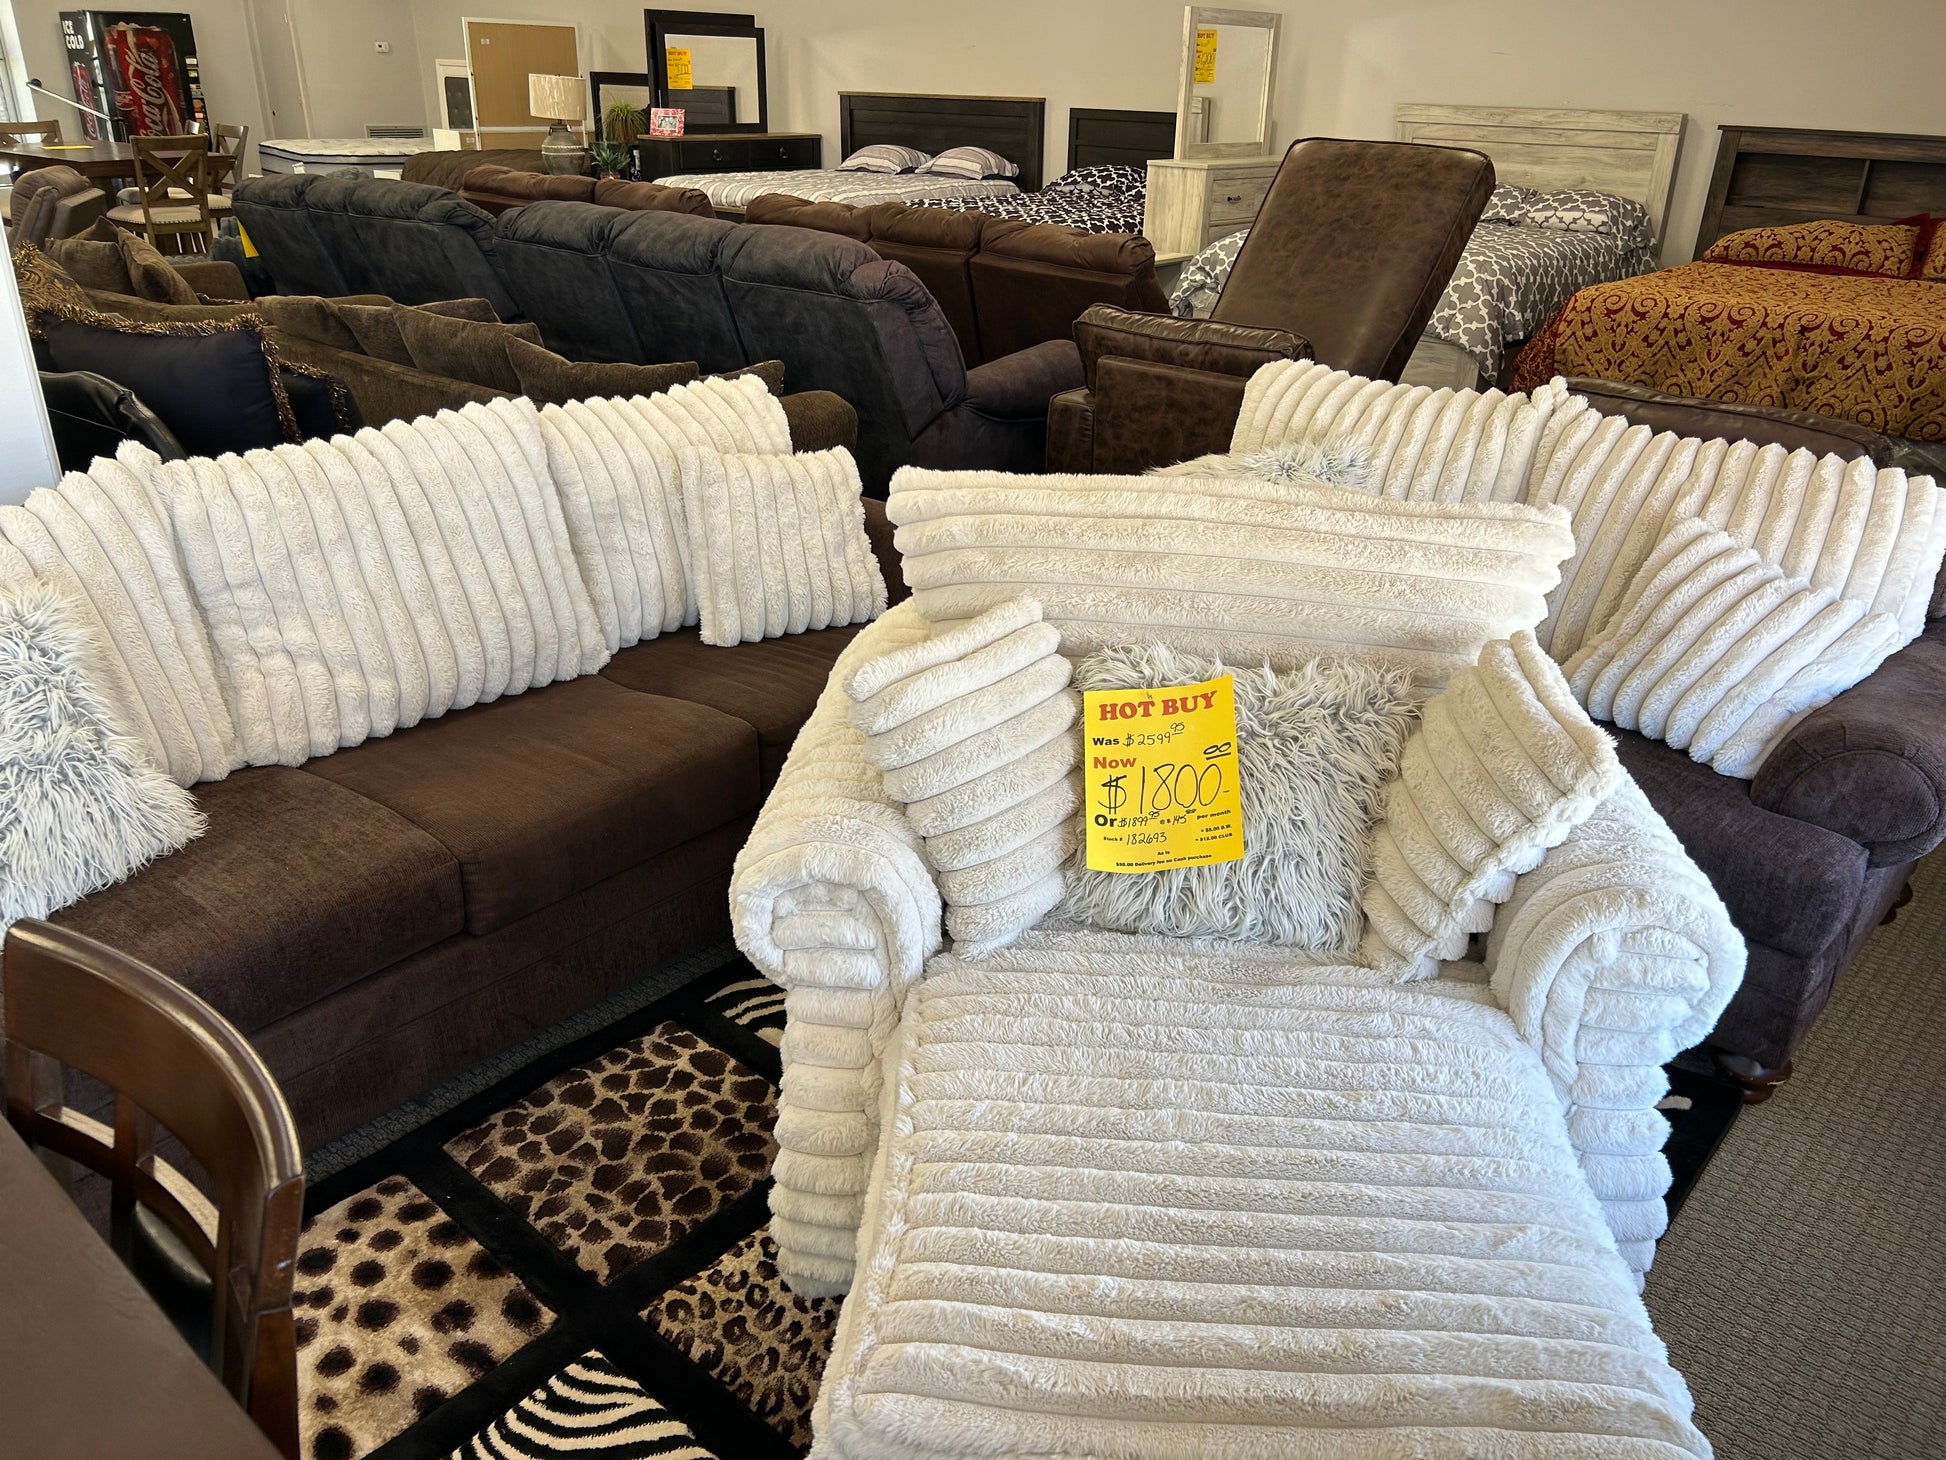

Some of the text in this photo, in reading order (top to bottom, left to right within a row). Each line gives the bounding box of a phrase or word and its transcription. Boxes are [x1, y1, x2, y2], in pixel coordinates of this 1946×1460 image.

[62, 20, 75, 34] ICE
[66, 35, 84, 50] COLD
[1099, 690, 1217, 720] HOT BUY
[1092, 737, 1120, 746] Was
[1094, 756, 1137, 769] Now
[1094, 814, 1117, 827] Or
[1210, 809, 1231, 817] month
[1127, 831, 1167, 845] 182693
